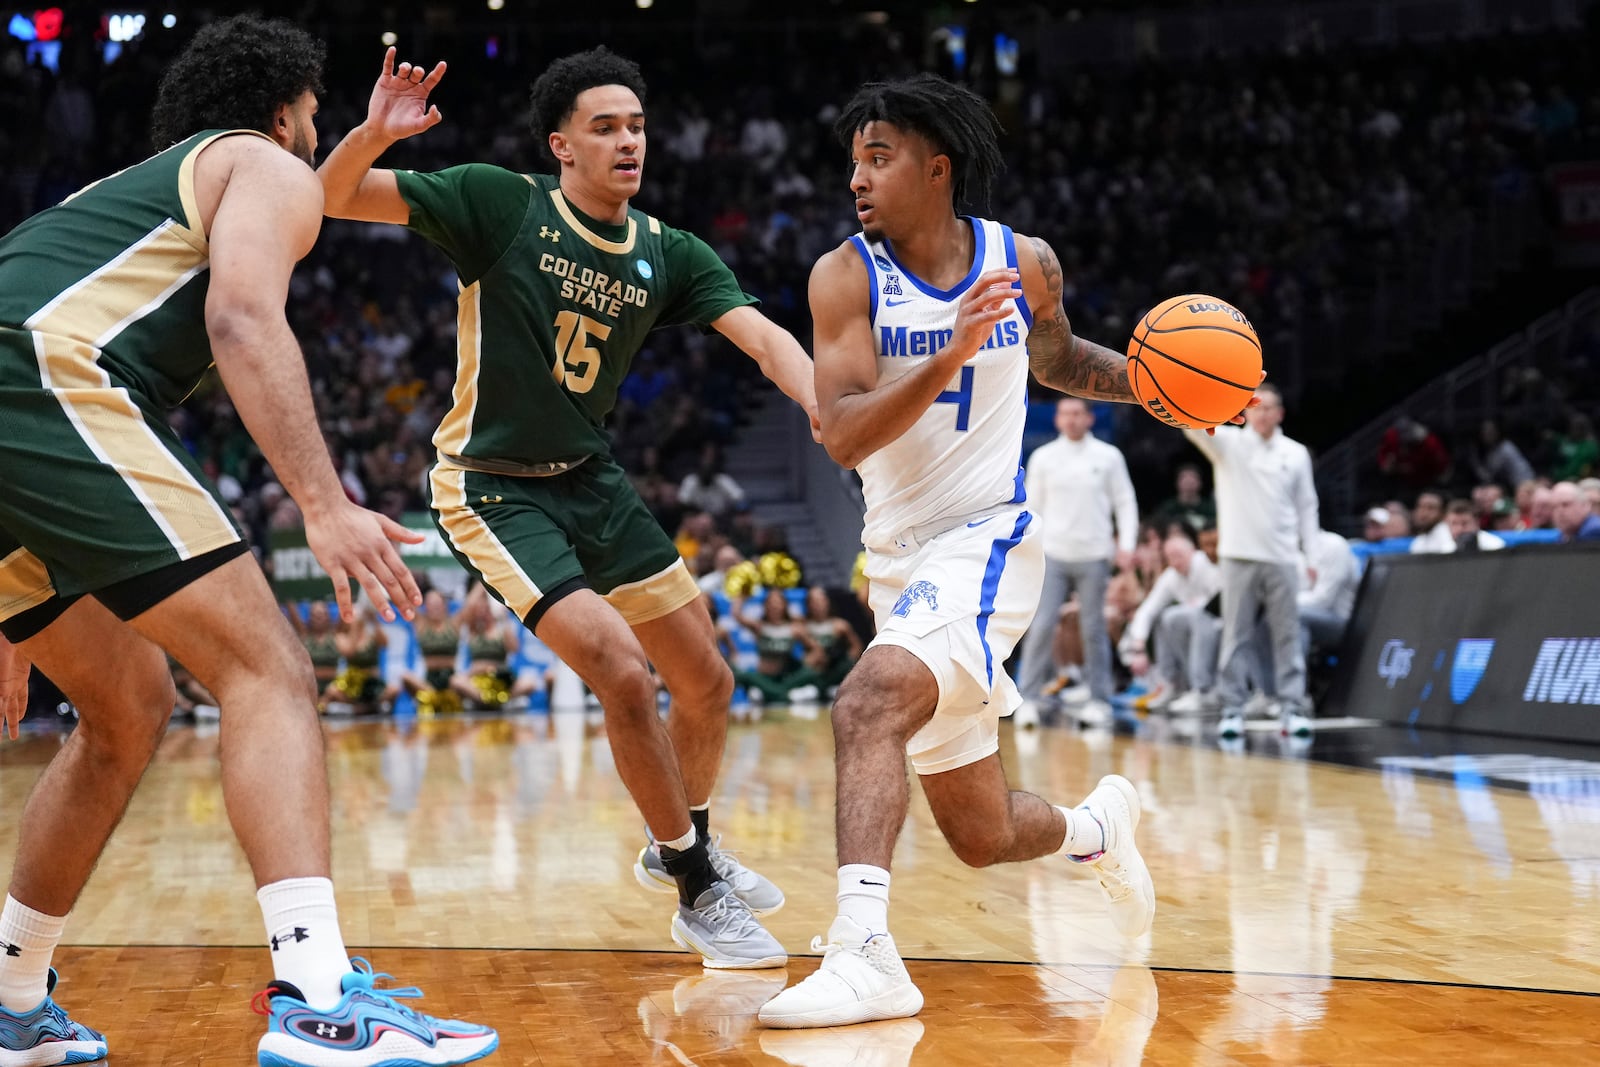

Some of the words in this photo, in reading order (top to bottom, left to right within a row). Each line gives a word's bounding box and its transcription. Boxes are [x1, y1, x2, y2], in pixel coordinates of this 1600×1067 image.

[538, 252, 648, 308] COLORADO
[560, 280, 624, 318] STATE
[552, 309, 612, 394] 15
[880, 320, 1020, 357] Memis
[933, 366, 975, 432] 4
